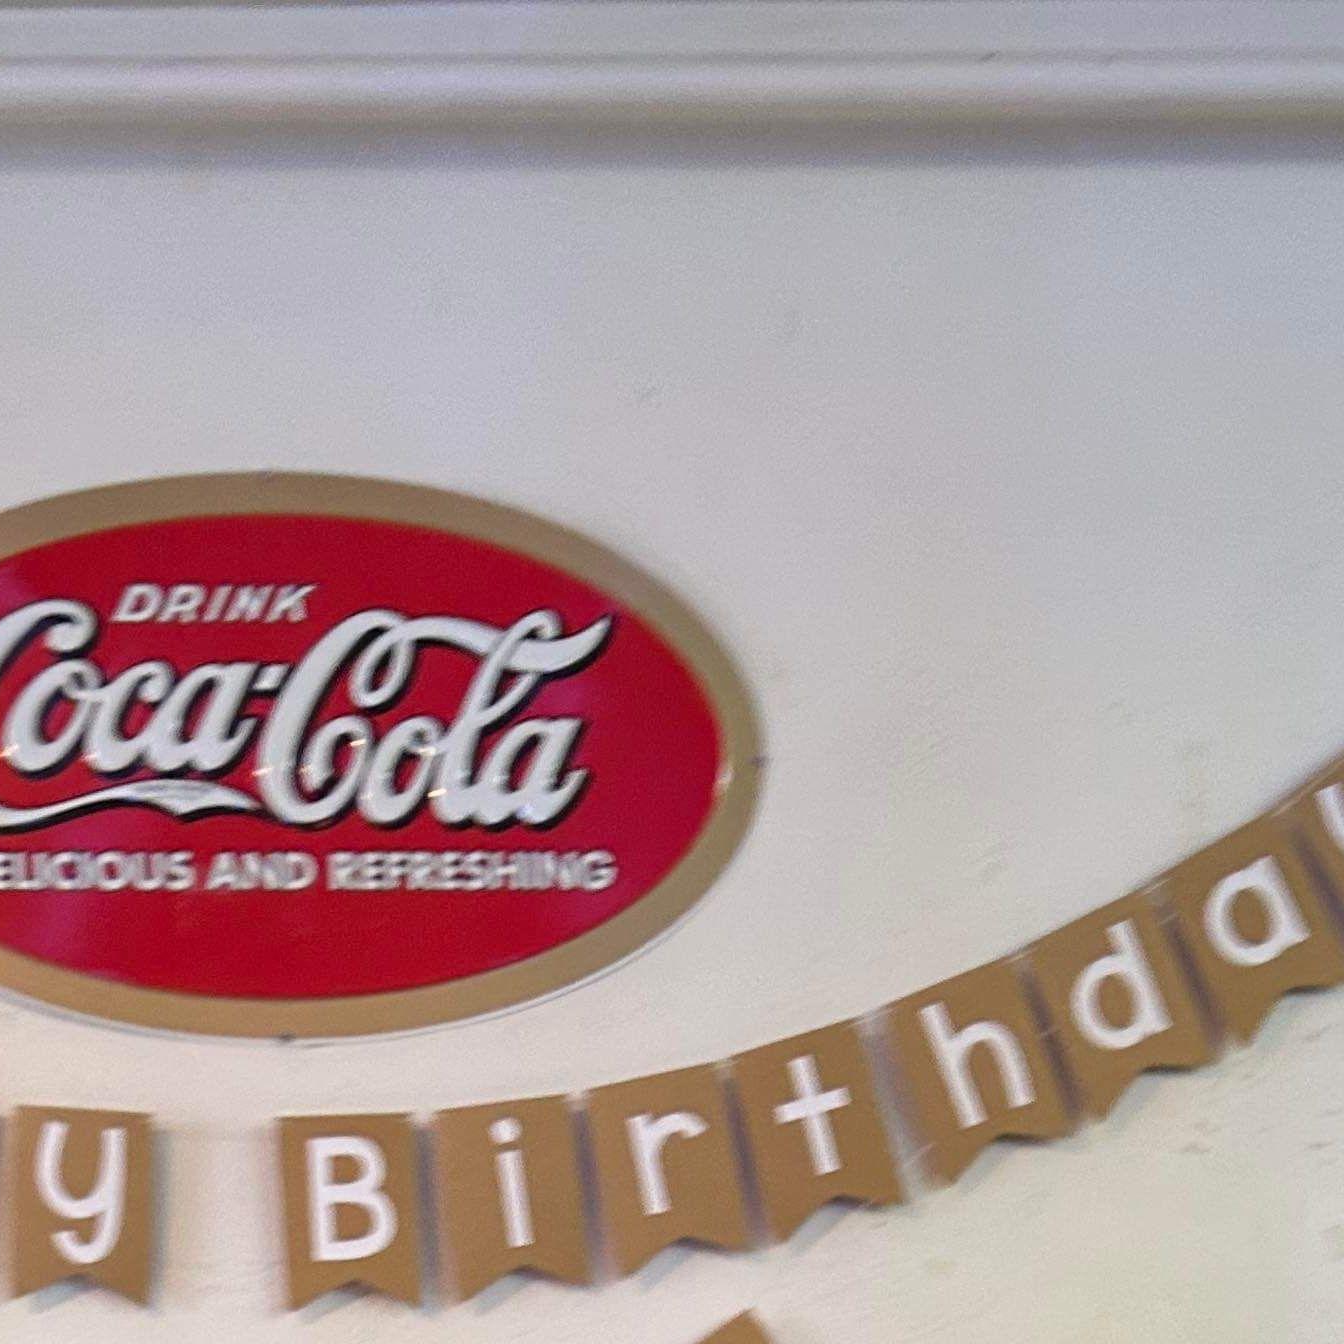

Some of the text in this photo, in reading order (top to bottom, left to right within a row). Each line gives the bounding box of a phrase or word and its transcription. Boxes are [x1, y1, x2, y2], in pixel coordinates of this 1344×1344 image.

[112, 583, 314, 623] DRINK
[206, 851, 314, 892] AND
[328, 851, 616, 892] REFRESHING
